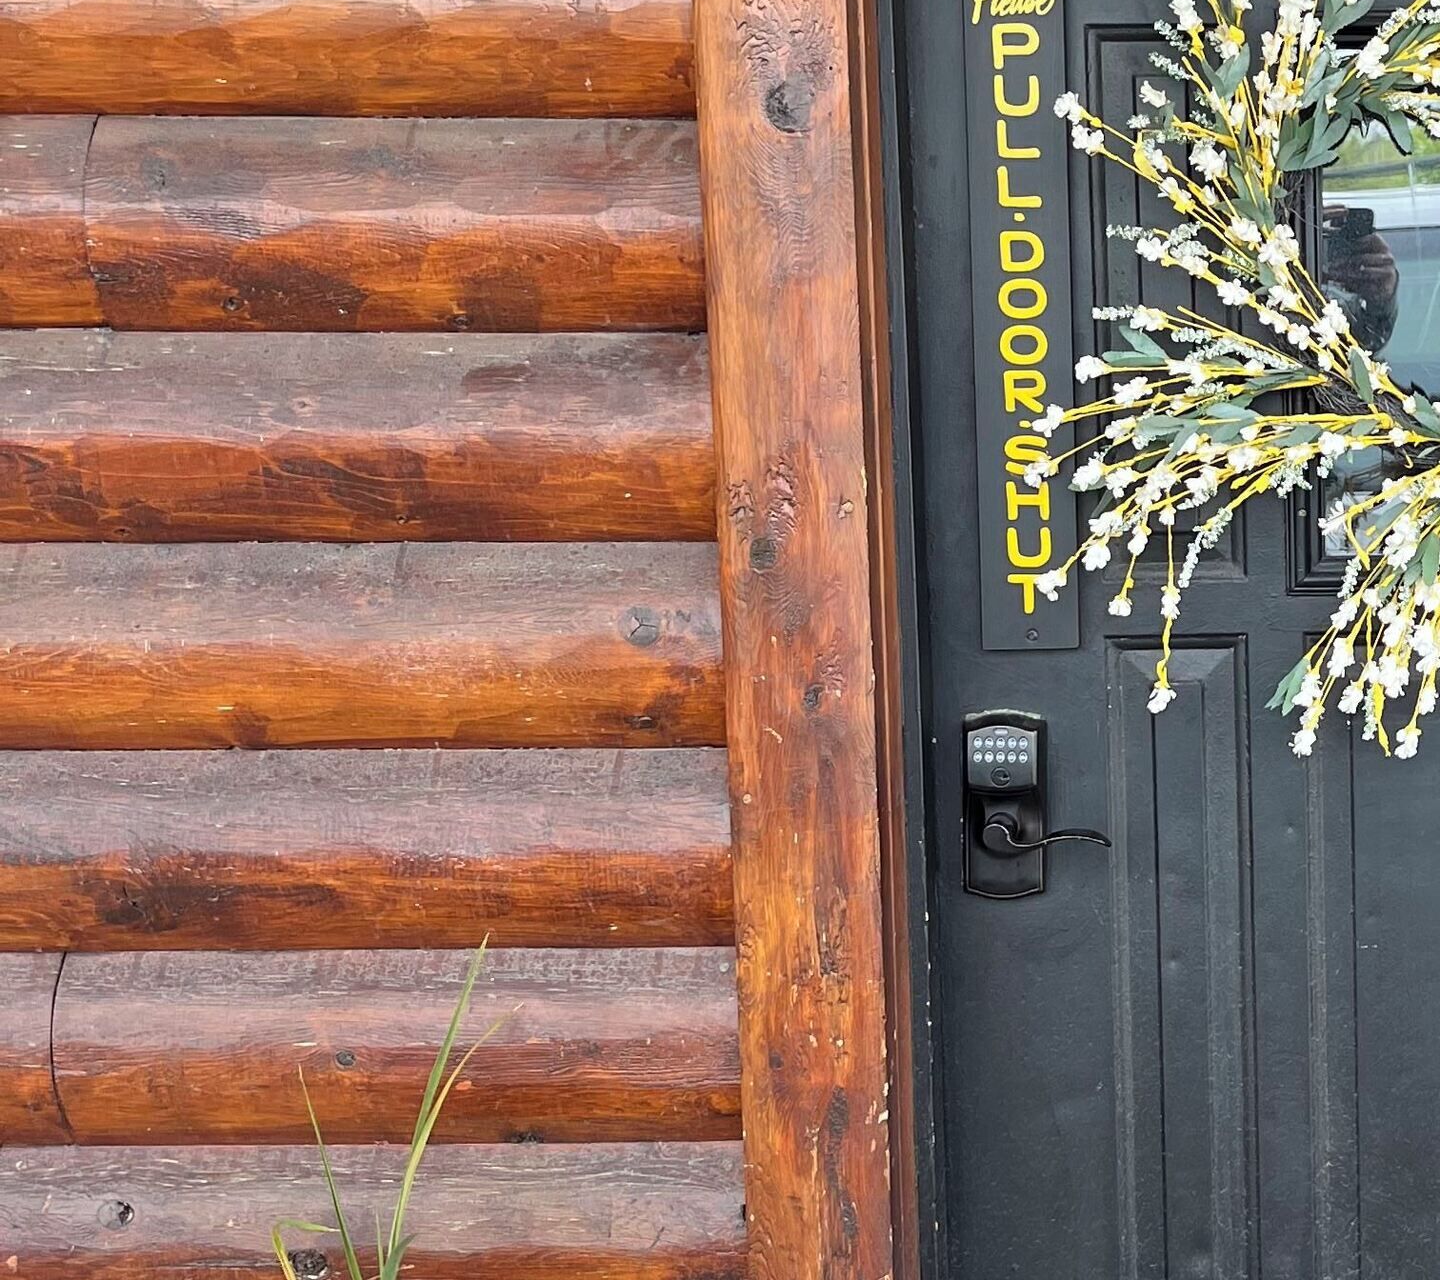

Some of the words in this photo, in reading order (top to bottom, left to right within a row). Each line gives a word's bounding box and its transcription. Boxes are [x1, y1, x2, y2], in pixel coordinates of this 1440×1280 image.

[991, 22, 1043, 210] PULL
[998, 230, 1049, 414] DOOR
[1003, 434, 1052, 615] SHUT
